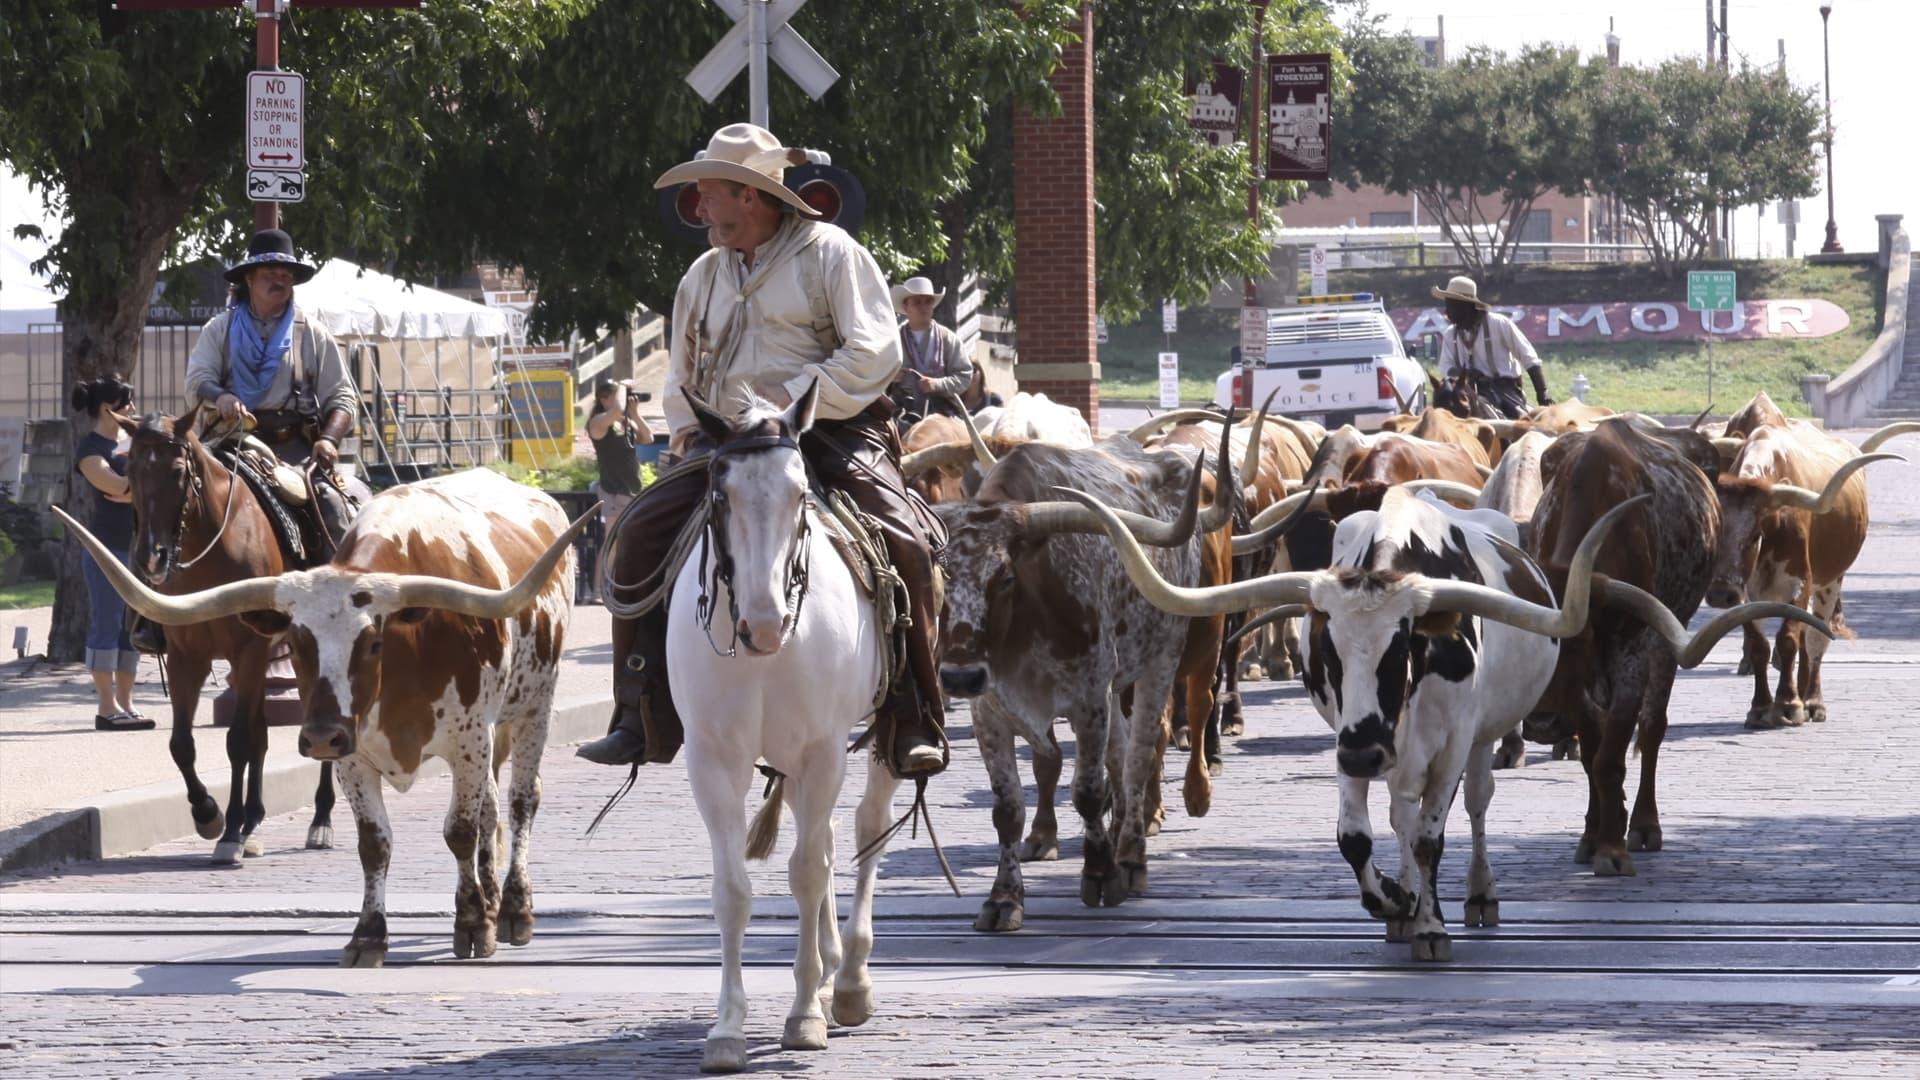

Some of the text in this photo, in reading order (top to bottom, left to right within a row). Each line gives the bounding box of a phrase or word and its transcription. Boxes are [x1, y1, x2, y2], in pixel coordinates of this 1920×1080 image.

[265, 80, 286, 95] NO
[255, 97, 296, 110] PARKING
[252, 110, 298, 123] STOPPING
[269, 124, 282, 135] OR
[252, 136, 298, 149] STANDING
[1403, 302, 1814, 341] AMOUR
[1354, 363, 1373, 374] 218
[1272, 391, 1358, 406] OLICE
